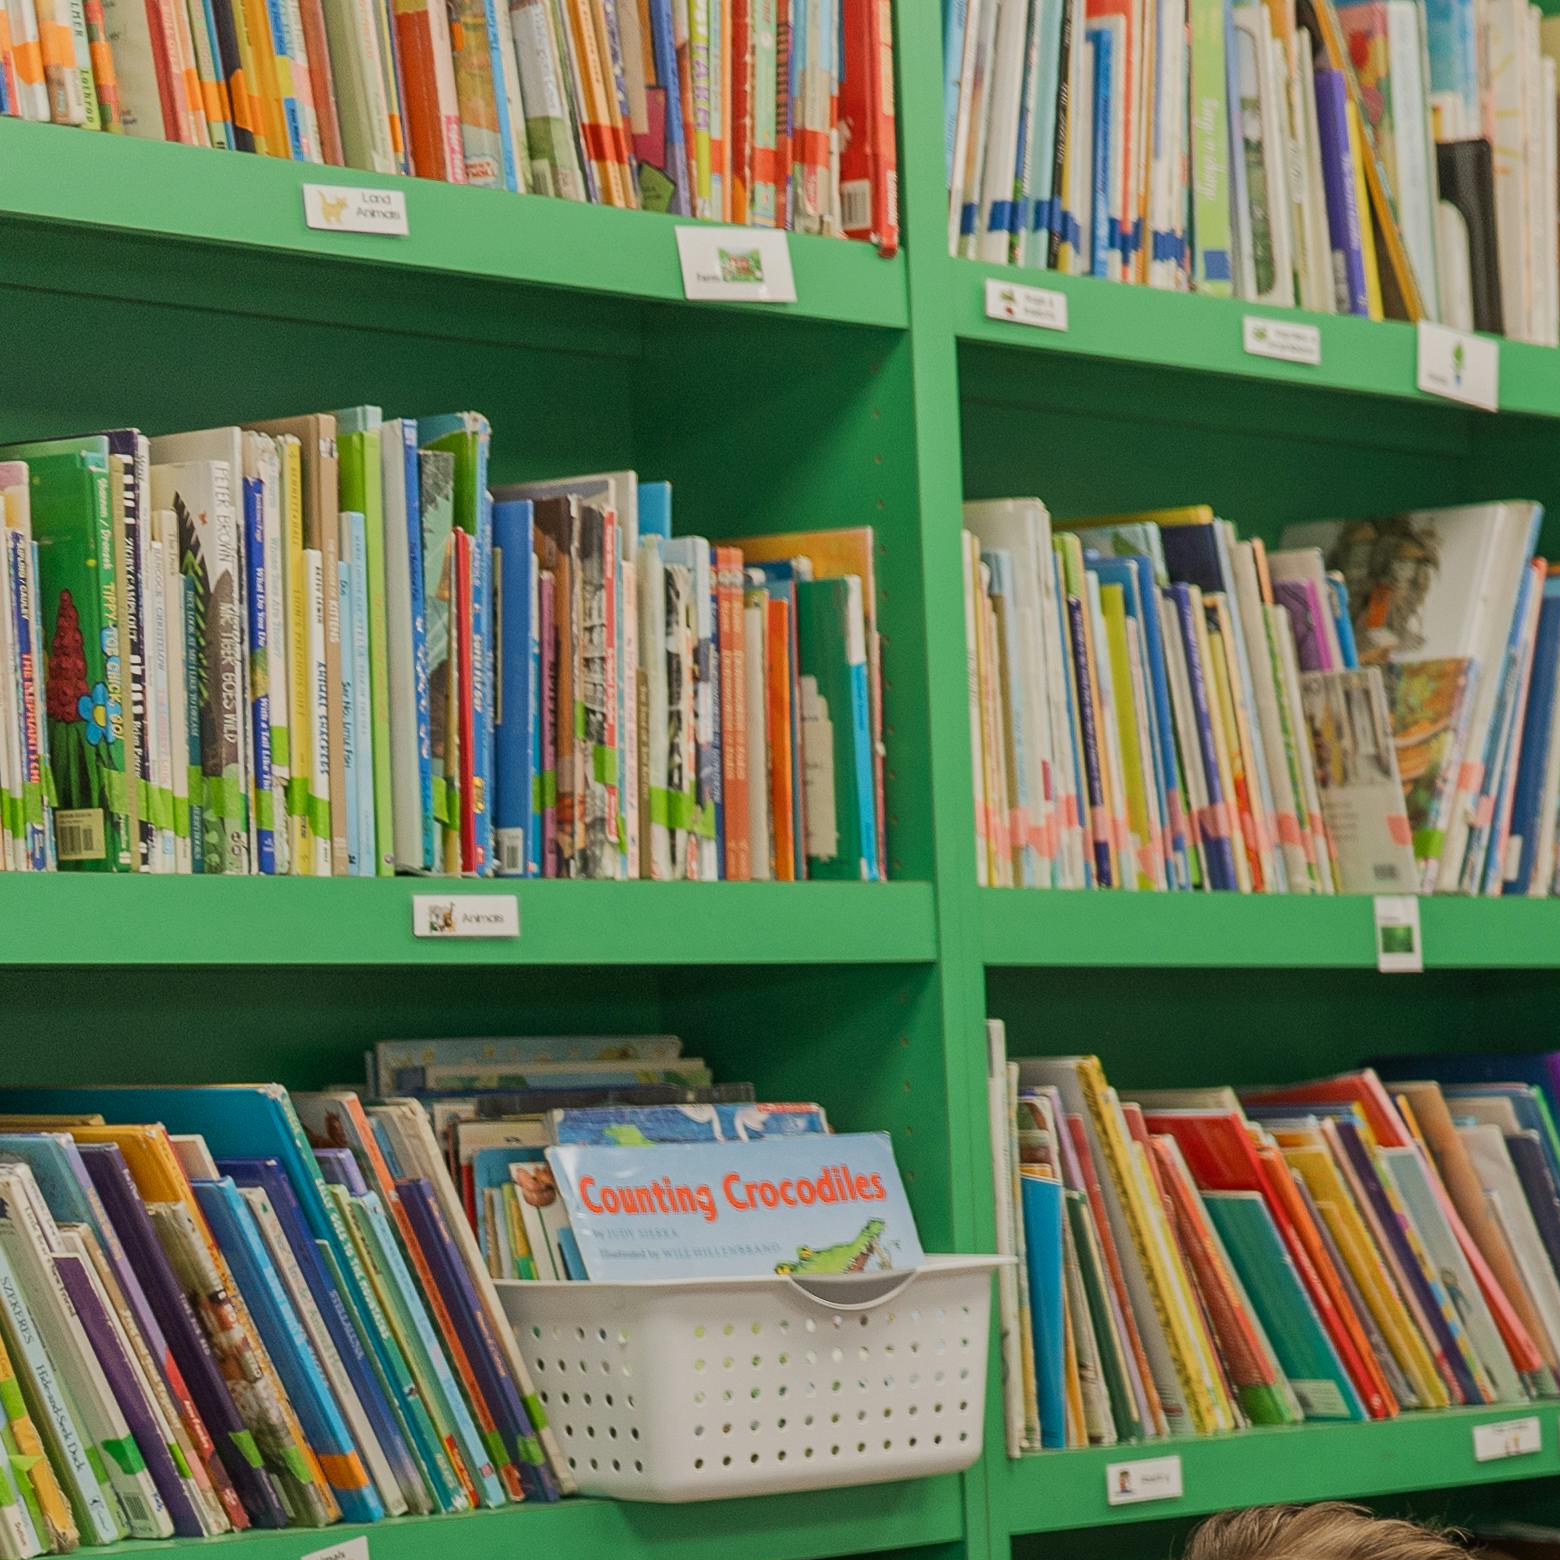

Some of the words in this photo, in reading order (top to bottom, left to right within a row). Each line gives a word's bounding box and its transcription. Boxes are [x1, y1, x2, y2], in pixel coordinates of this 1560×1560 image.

[214, 467, 231, 508] PETER
[217, 514, 235, 565] BROWN
[221, 672, 237, 710] GOES
[222, 714, 238, 744] WILD
[580, 1174, 718, 1224] Counting
[722, 1163, 886, 1210] Crocodiles
[0, 1276, 35, 1345] SZEKERES
[35, 1364, 74, 1441] Hide-and-Seek
[66, 1442, 87, 1472] Duck
